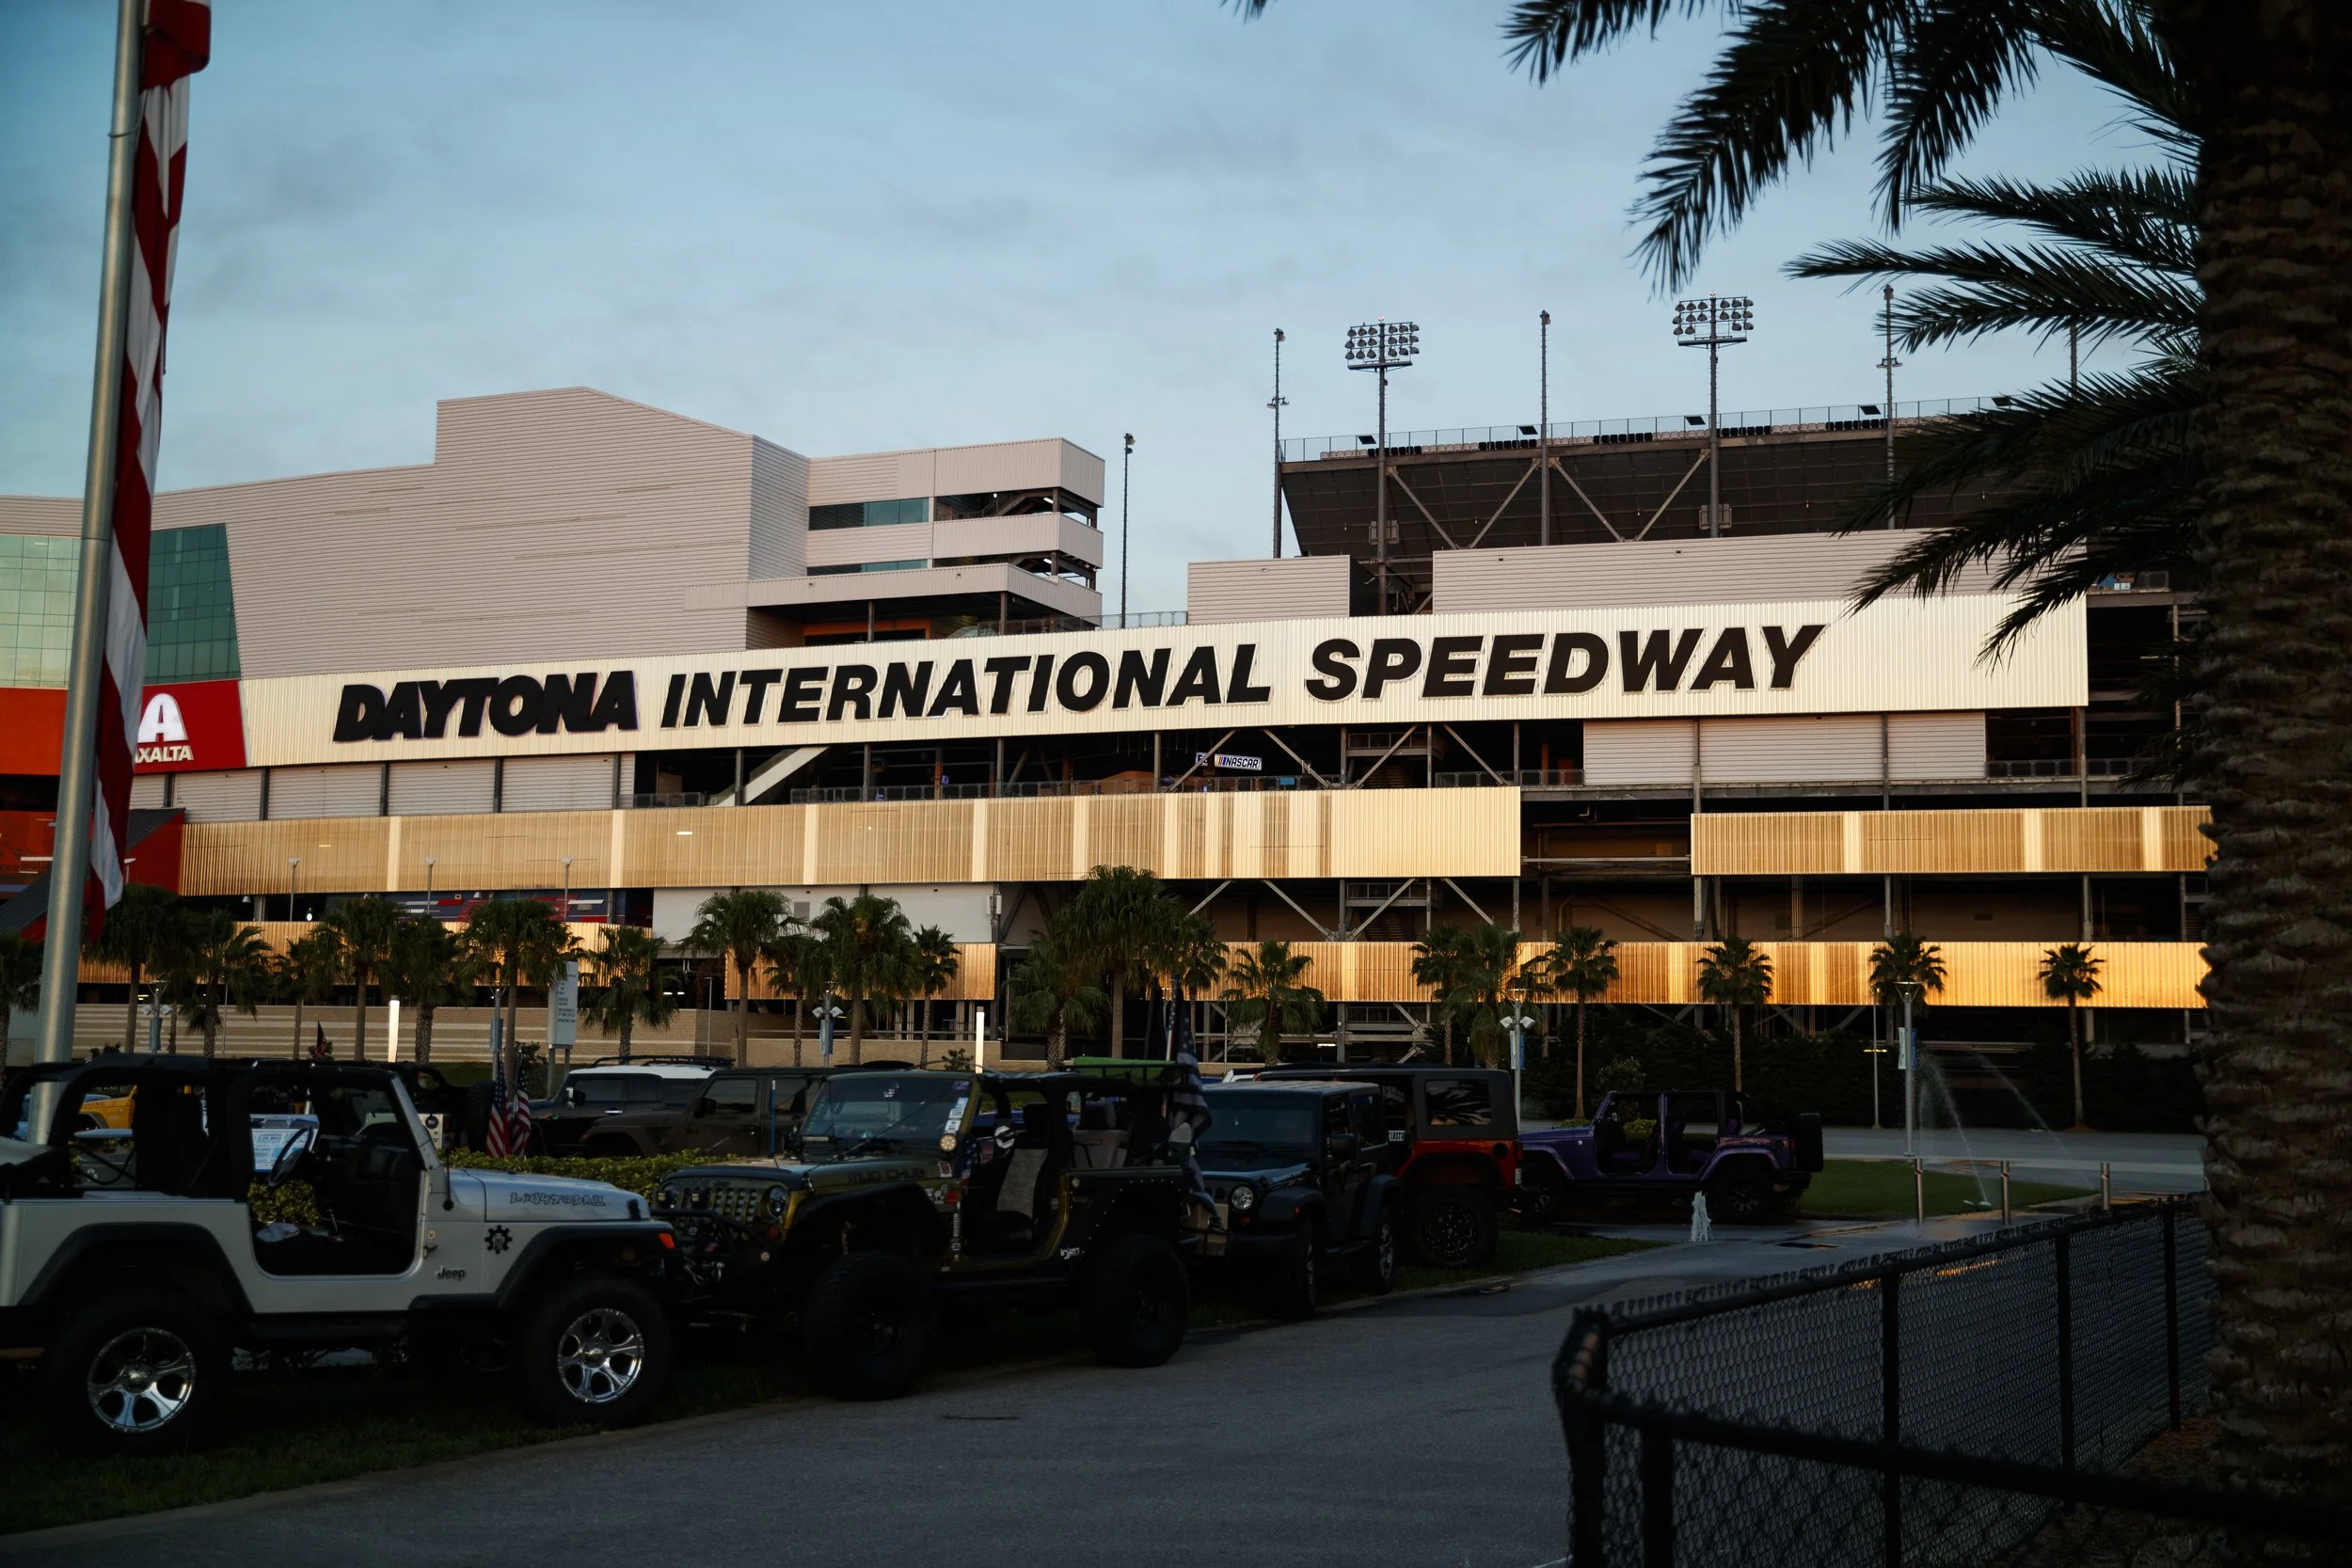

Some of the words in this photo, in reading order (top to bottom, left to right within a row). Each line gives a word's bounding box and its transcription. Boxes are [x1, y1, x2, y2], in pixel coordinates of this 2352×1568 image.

[333, 671, 637, 742] DAYTONA
[661, 644, 1271, 728] INTERNATIONAL
[1305, 626, 1826, 702] SPEEDWAY
[1226, 756, 1259, 768] NASCAR
[437, 1267, 466, 1280] Jeep
